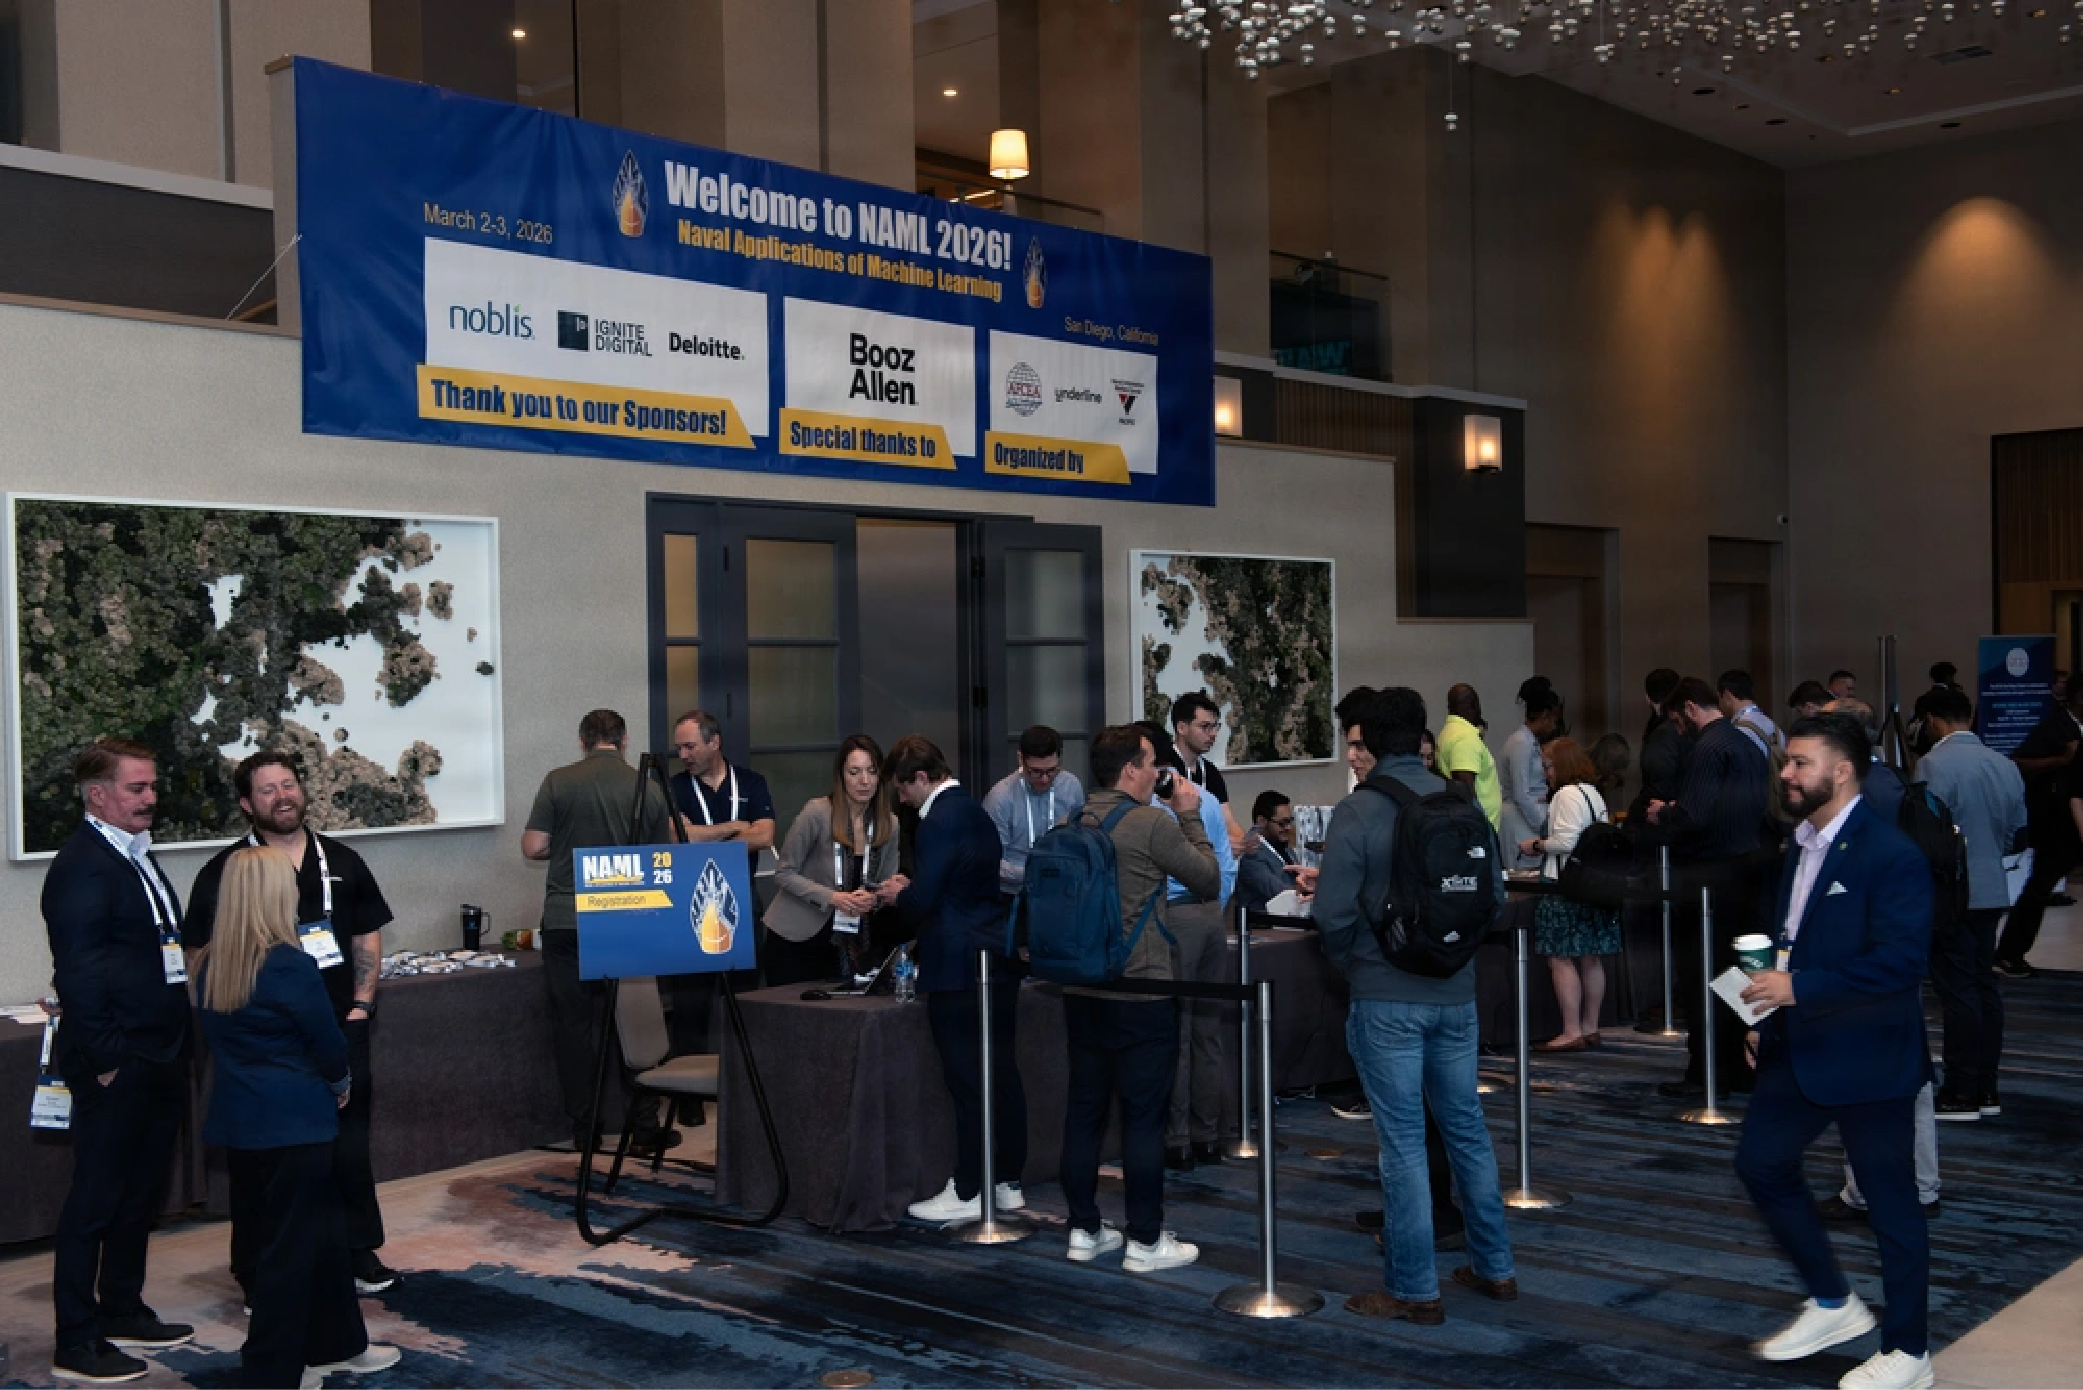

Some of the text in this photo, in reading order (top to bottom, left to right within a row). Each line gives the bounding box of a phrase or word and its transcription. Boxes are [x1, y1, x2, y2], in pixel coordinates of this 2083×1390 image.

[423, 202, 553, 245] March 2-3, 2026
[665, 159, 1011, 272] Welcome to NAML 2026!
[678, 218, 1003, 303] Naval Applications of Machine Learning
[594, 318, 645, 341] IGNITE
[594, 334, 653, 357] DIGITAL
[1064, 316, 1159, 347] San Diego, California
[849, 332, 916, 373] Booz
[848, 368, 917, 406] Allen
[1053, 387, 1103, 405] underline
[430, 378, 728, 436] Thank you to our Sponsors!
[790, 420, 936, 459] Special thanks to
[994, 441, 1084, 475] Organized by
[582, 854, 645, 881] NAML
[653, 851, 672, 868] 20
[653, 869, 673, 884] 26
[588, 895, 646, 908] Registration
